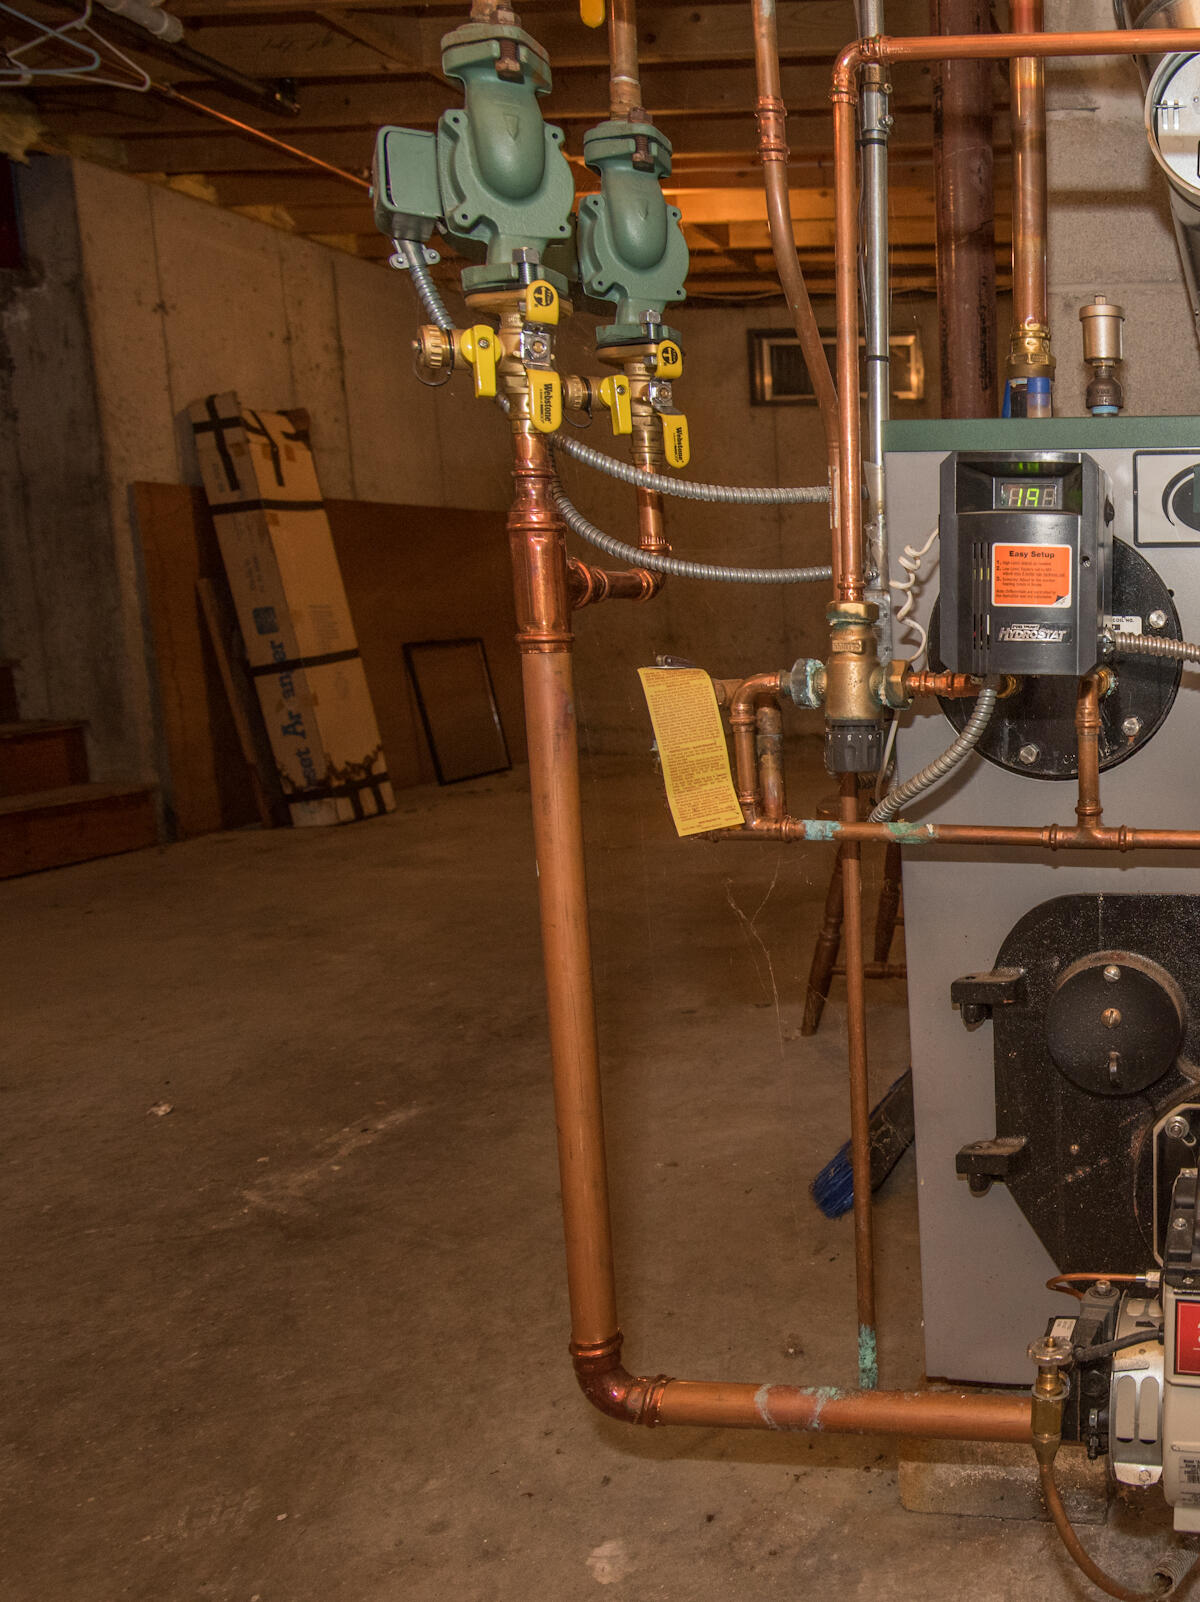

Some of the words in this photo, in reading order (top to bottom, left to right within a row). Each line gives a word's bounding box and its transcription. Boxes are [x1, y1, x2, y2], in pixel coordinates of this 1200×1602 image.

[544, 384, 552, 422] Webstone
[1009, 550, 1028, 558] Easy
[1031, 551, 1055, 559] Setup
